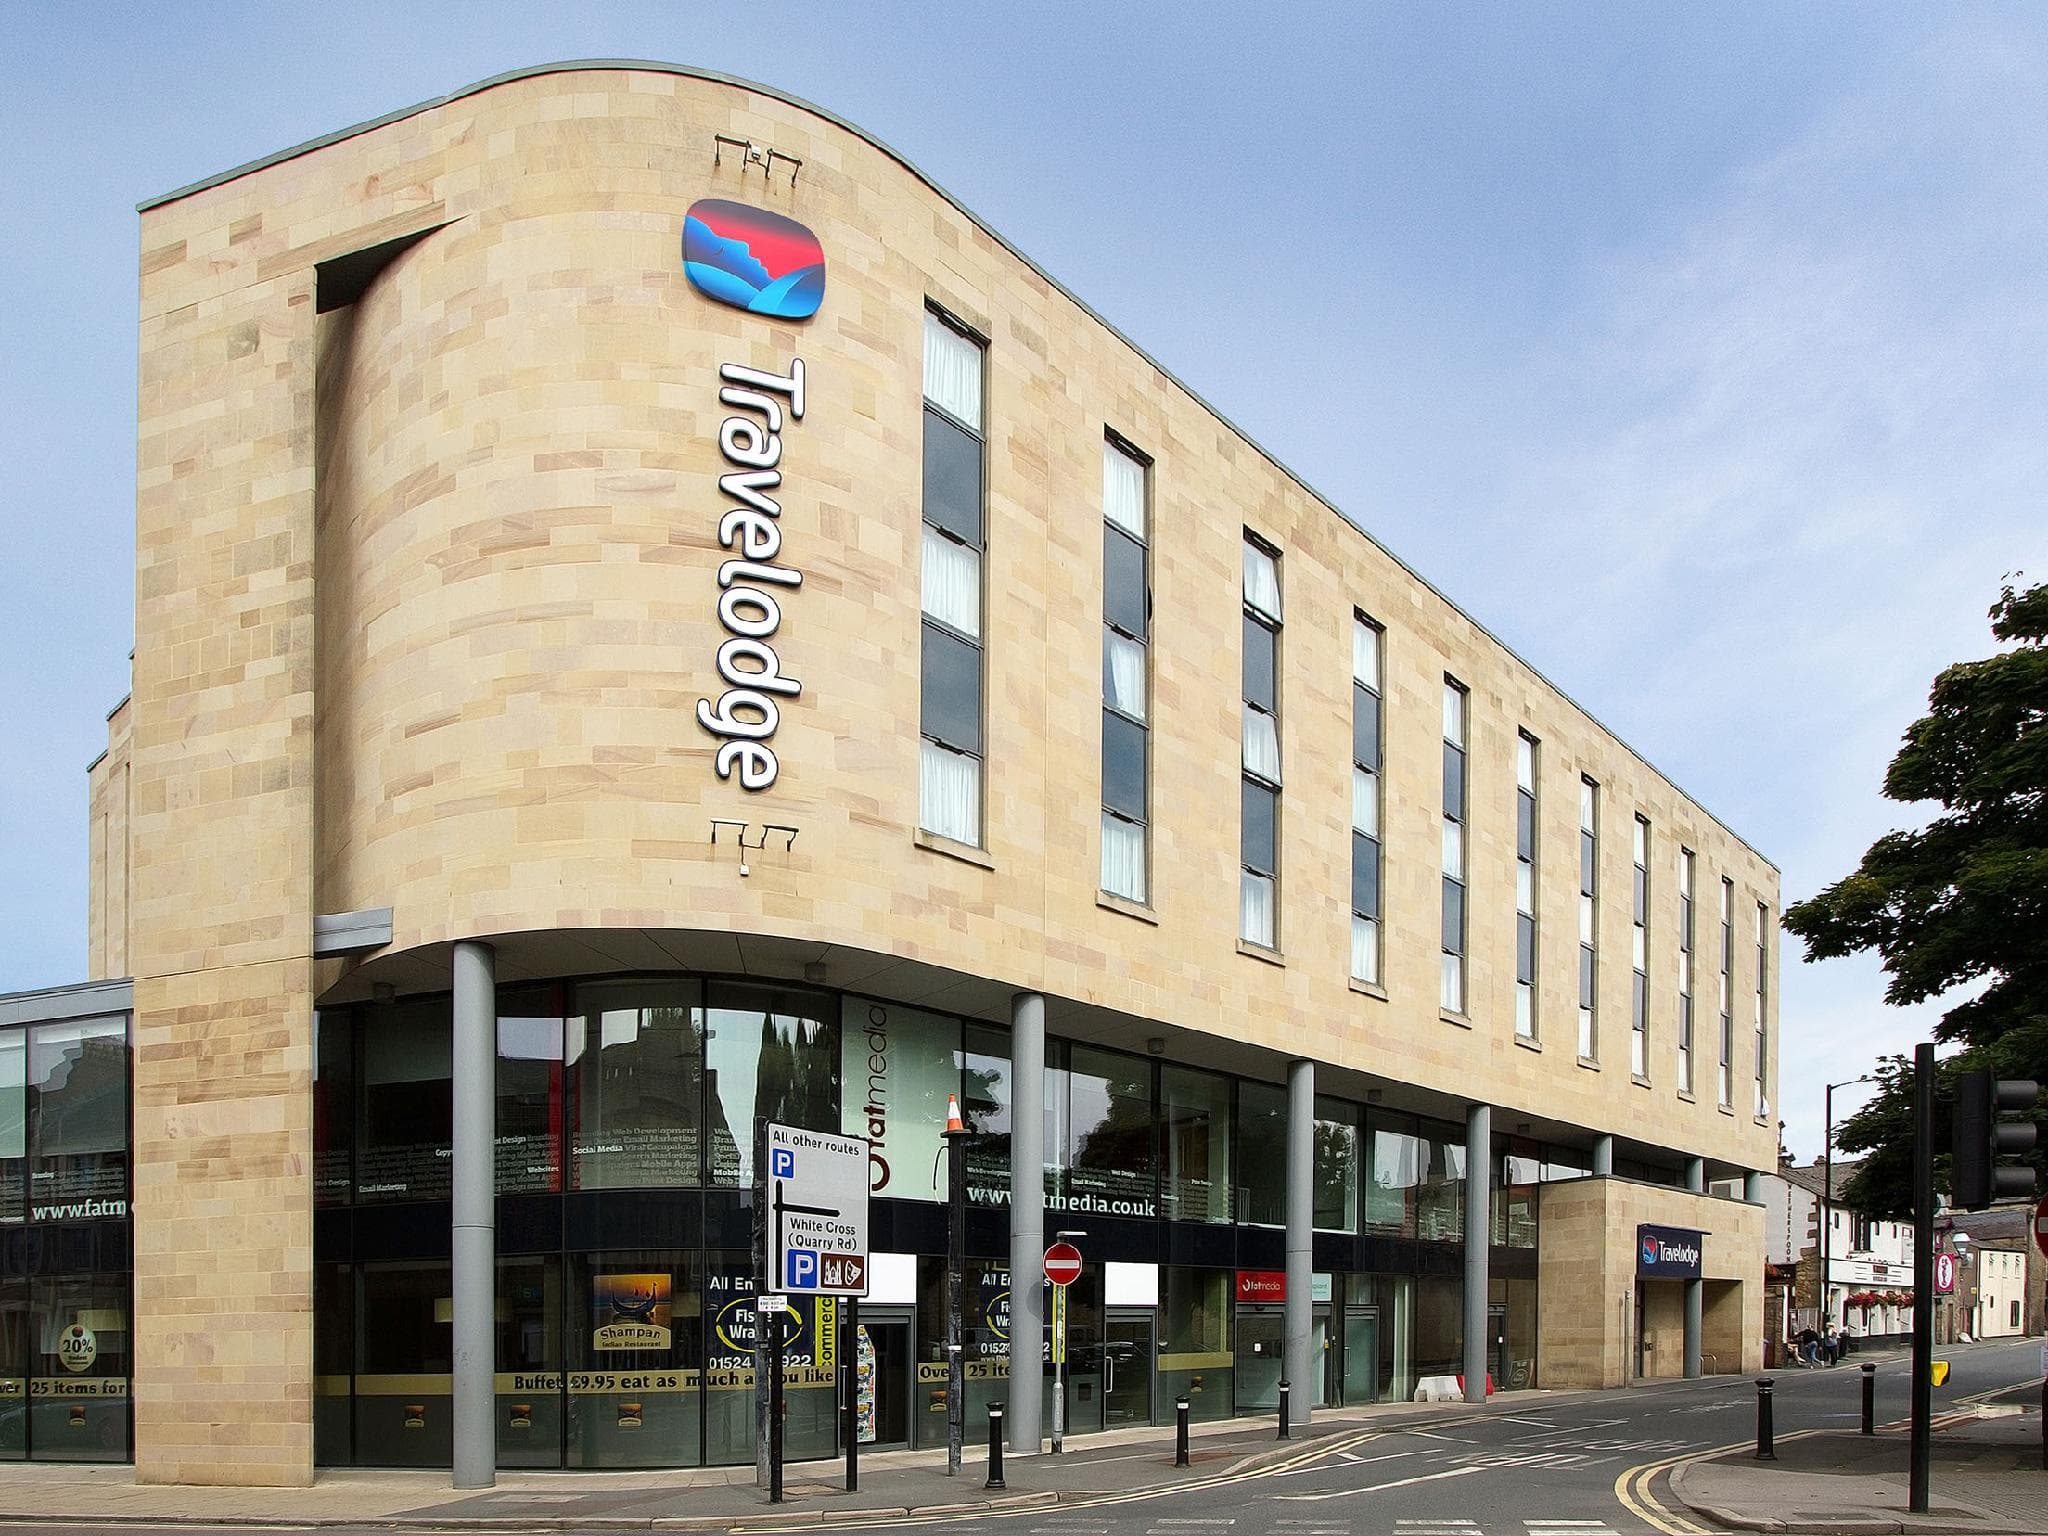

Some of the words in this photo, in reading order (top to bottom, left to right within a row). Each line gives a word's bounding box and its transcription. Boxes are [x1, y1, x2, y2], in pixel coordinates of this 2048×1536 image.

[696, 357, 806, 793] Travelodge
[597, 1145, 624, 1153] Media
[773, 1130, 790, 1143] All
[792, 1134, 822, 1149] other
[825, 1141, 860, 1156] routes
[777, 1151, 791, 1175] P
[790, 1217, 823, 1232] White
[825, 1221, 856, 1236] Cross
[788, 1232, 834, 1250] (Quarry
[837, 1236, 858, 1251] Rd)
[1659, 1240, 1699, 1267] Travelodge
[795, 1254, 814, 1286] P
[709, 1276, 728, 1290] All
[981, 1273, 997, 1286] All
[600, 1327, 661, 1340] Shampan
[62, 1339, 94, 1354] 20%
[709, 1355, 752, 1370] 01524
[920, 1365, 949, 1379] Ove
[968, 1364, 988, 1377] 25
[992, 1362, 1010, 1377] ite
[0, 1383, 20, 1394] ver
[31, 1381, 48, 1394] 25
[54, 1380, 97, 1394] items
[102, 1379, 126, 1394] for
[514, 1375, 562, 1390] Buffet
[571, 1374, 615, 1390] £9.95
[620, 1375, 650, 1389] eat
[656, 1376, 677, 1388] as
[743, 1376, 755, 1386] a
[804, 1368, 834, 1383] like
